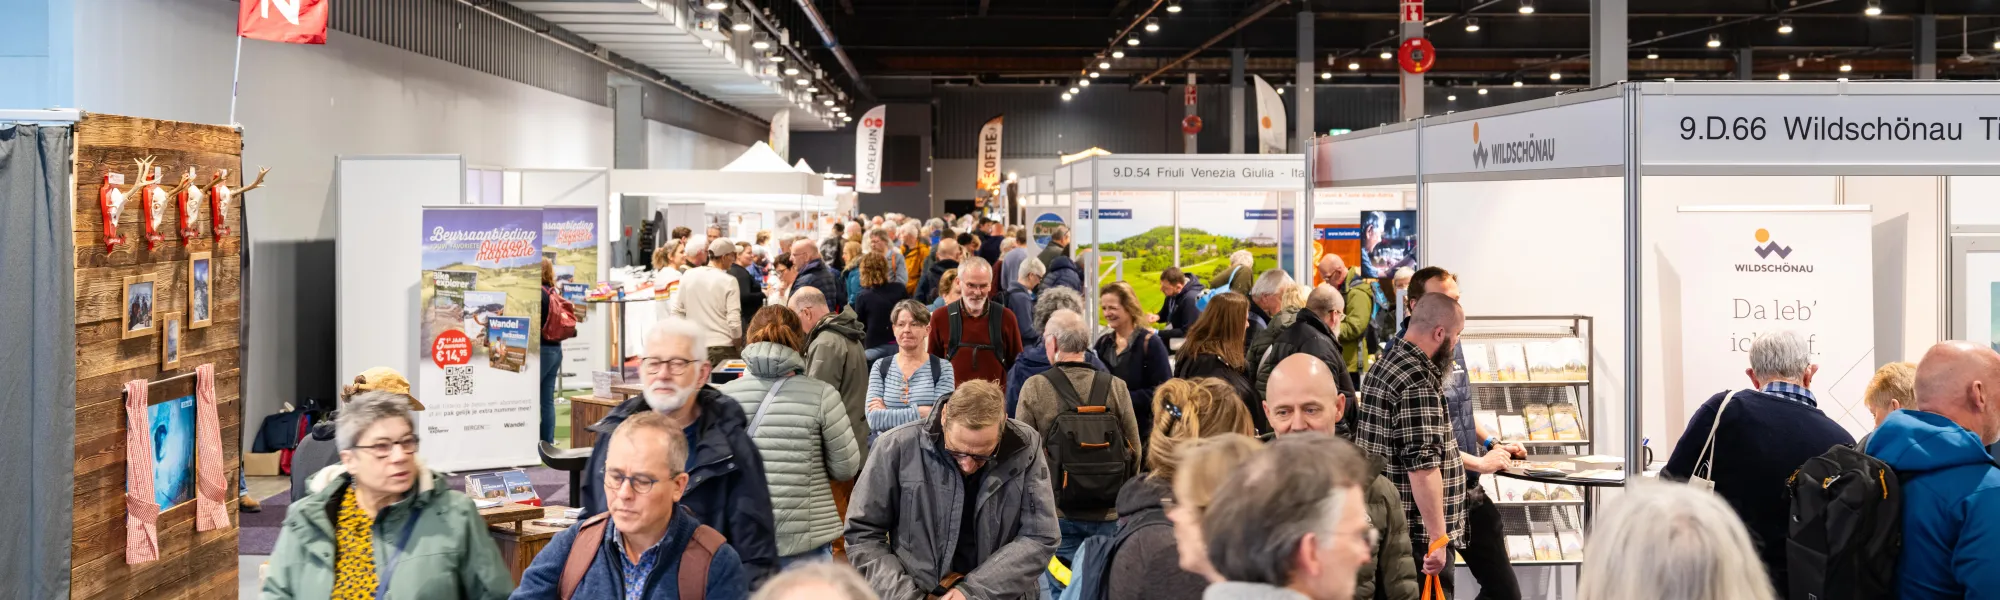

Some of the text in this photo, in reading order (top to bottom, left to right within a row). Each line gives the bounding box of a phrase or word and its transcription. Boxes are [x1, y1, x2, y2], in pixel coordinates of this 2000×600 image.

[1680, 116, 2000, 141] 9.D.66 Wildschönau Ti
[866, 128, 877, 184] ZADELPIJN
[984, 133, 997, 178] KOFFIE
[1491, 133, 1555, 164] WILDSCHÖNAU
[1113, 167, 1150, 178] 9.D.54
[1157, 167, 1185, 178] Friuli
[1191, 167, 1236, 178] Venezia
[1242, 167, 1274, 178] Giulia
[1291, 167, 1305, 178] Ita
[430, 226, 537, 243] Beursaanbieding
[480, 239, 529, 251] Outdoor
[475, 247, 535, 263] magazine
[433, 271, 450, 280] Bike
[1734, 262, 1814, 273] WILDSCHÖNAU
[436, 278, 470, 289] explorer
[1732, 298, 1767, 320] Da
[489, 318, 519, 329] Wandel
[436, 337, 446, 351] 5
[1731, 332, 1757, 352] ic
